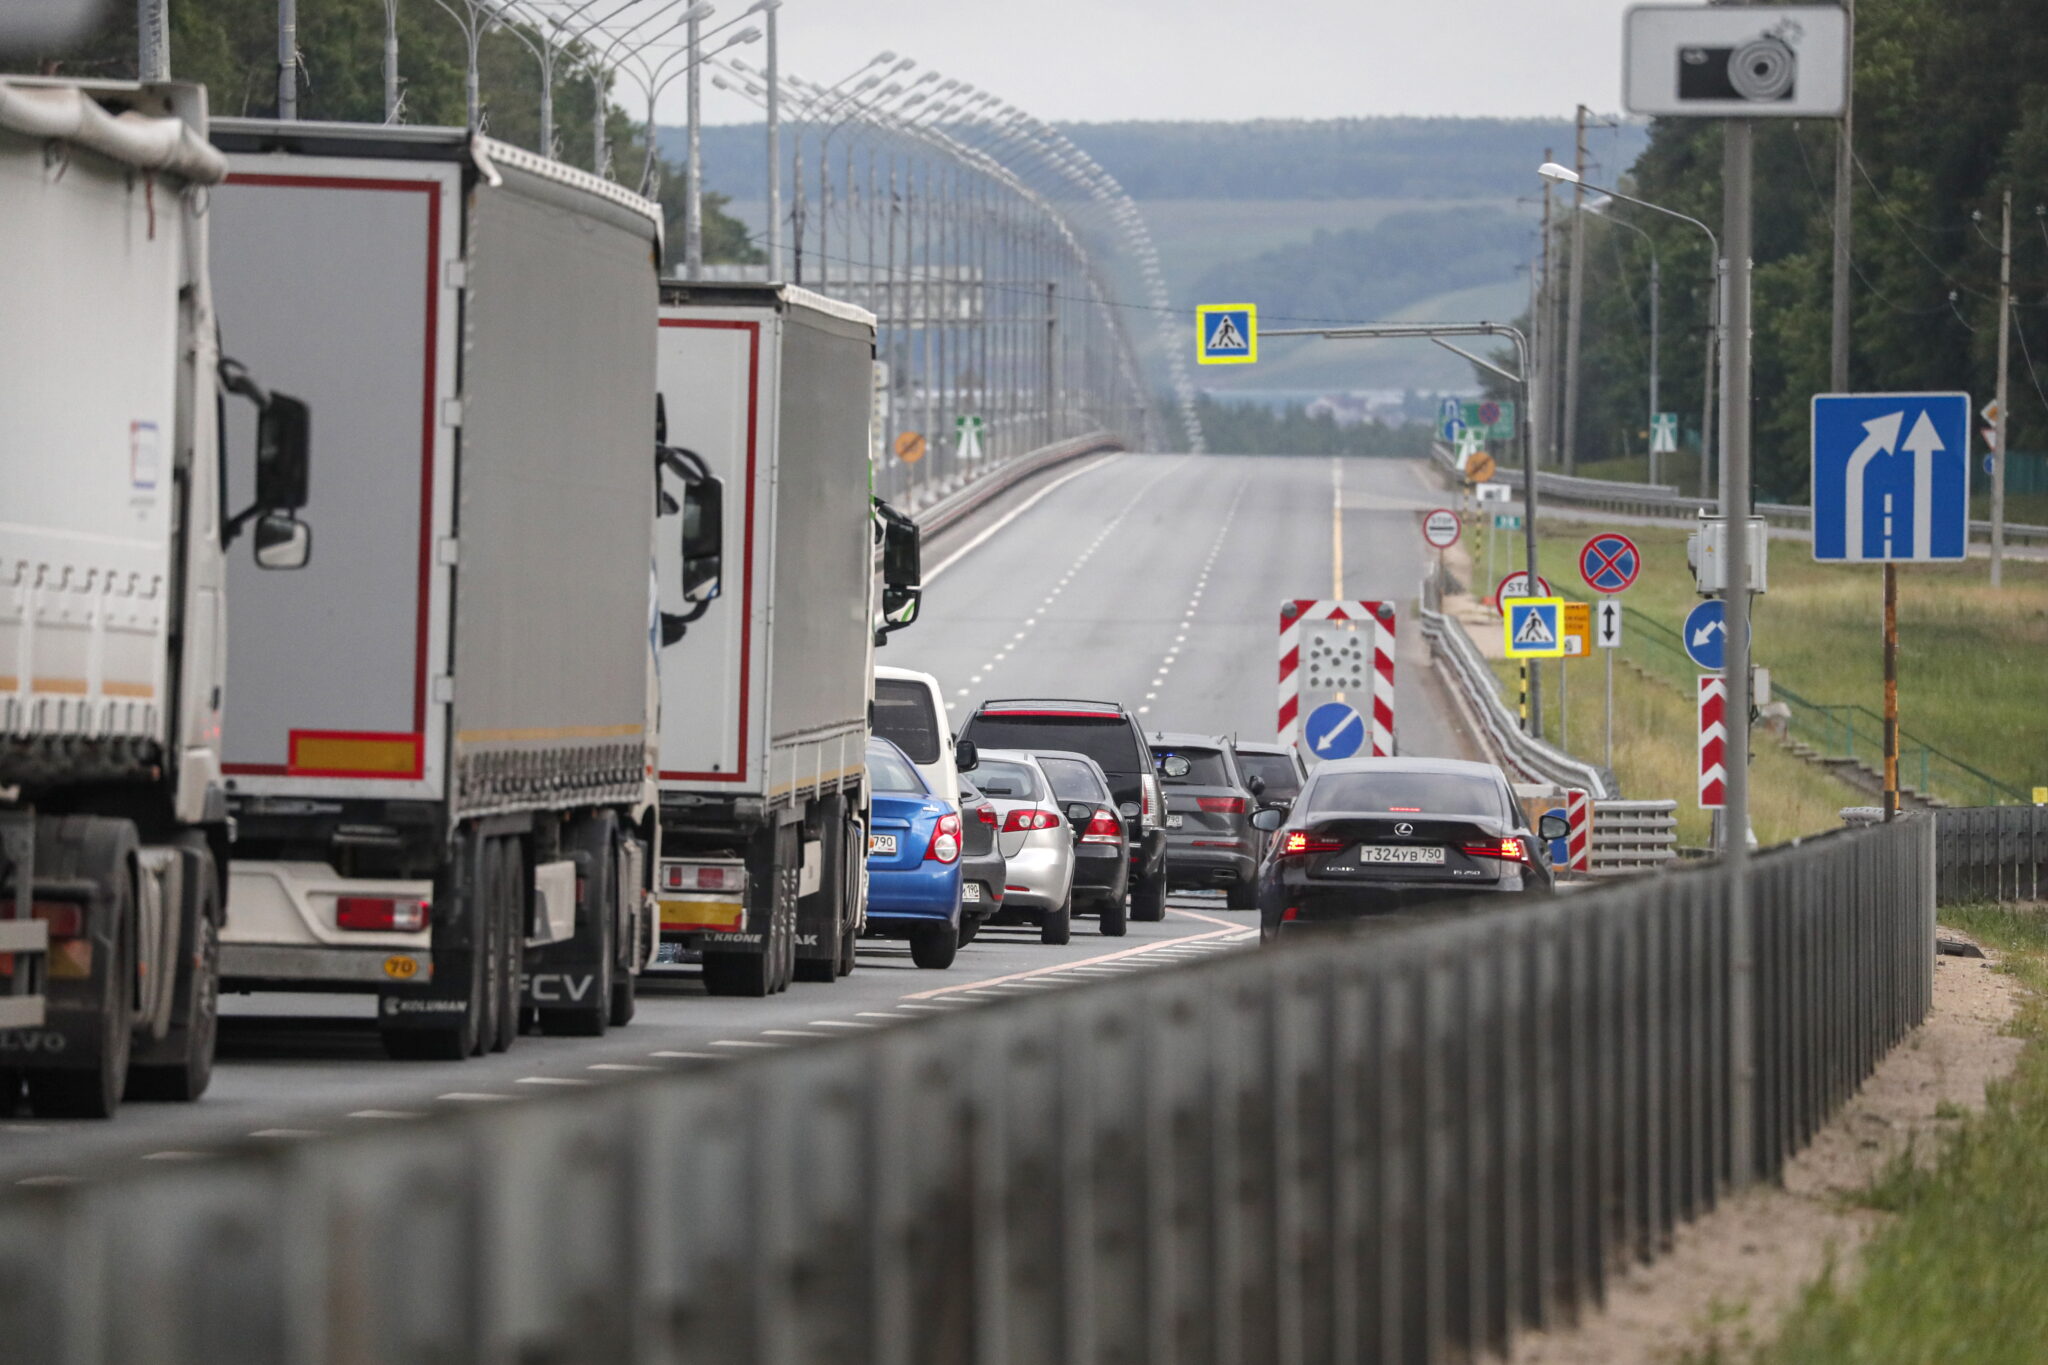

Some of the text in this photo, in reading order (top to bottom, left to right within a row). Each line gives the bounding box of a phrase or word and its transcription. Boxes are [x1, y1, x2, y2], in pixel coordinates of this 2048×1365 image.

[873, 836, 893, 847] 790
[1421, 848, 1441, 859] 750
[714, 933, 762, 944] KRONE
[389, 960, 413, 972] 70
[400, 1000, 468, 1013] KOLUMAN
